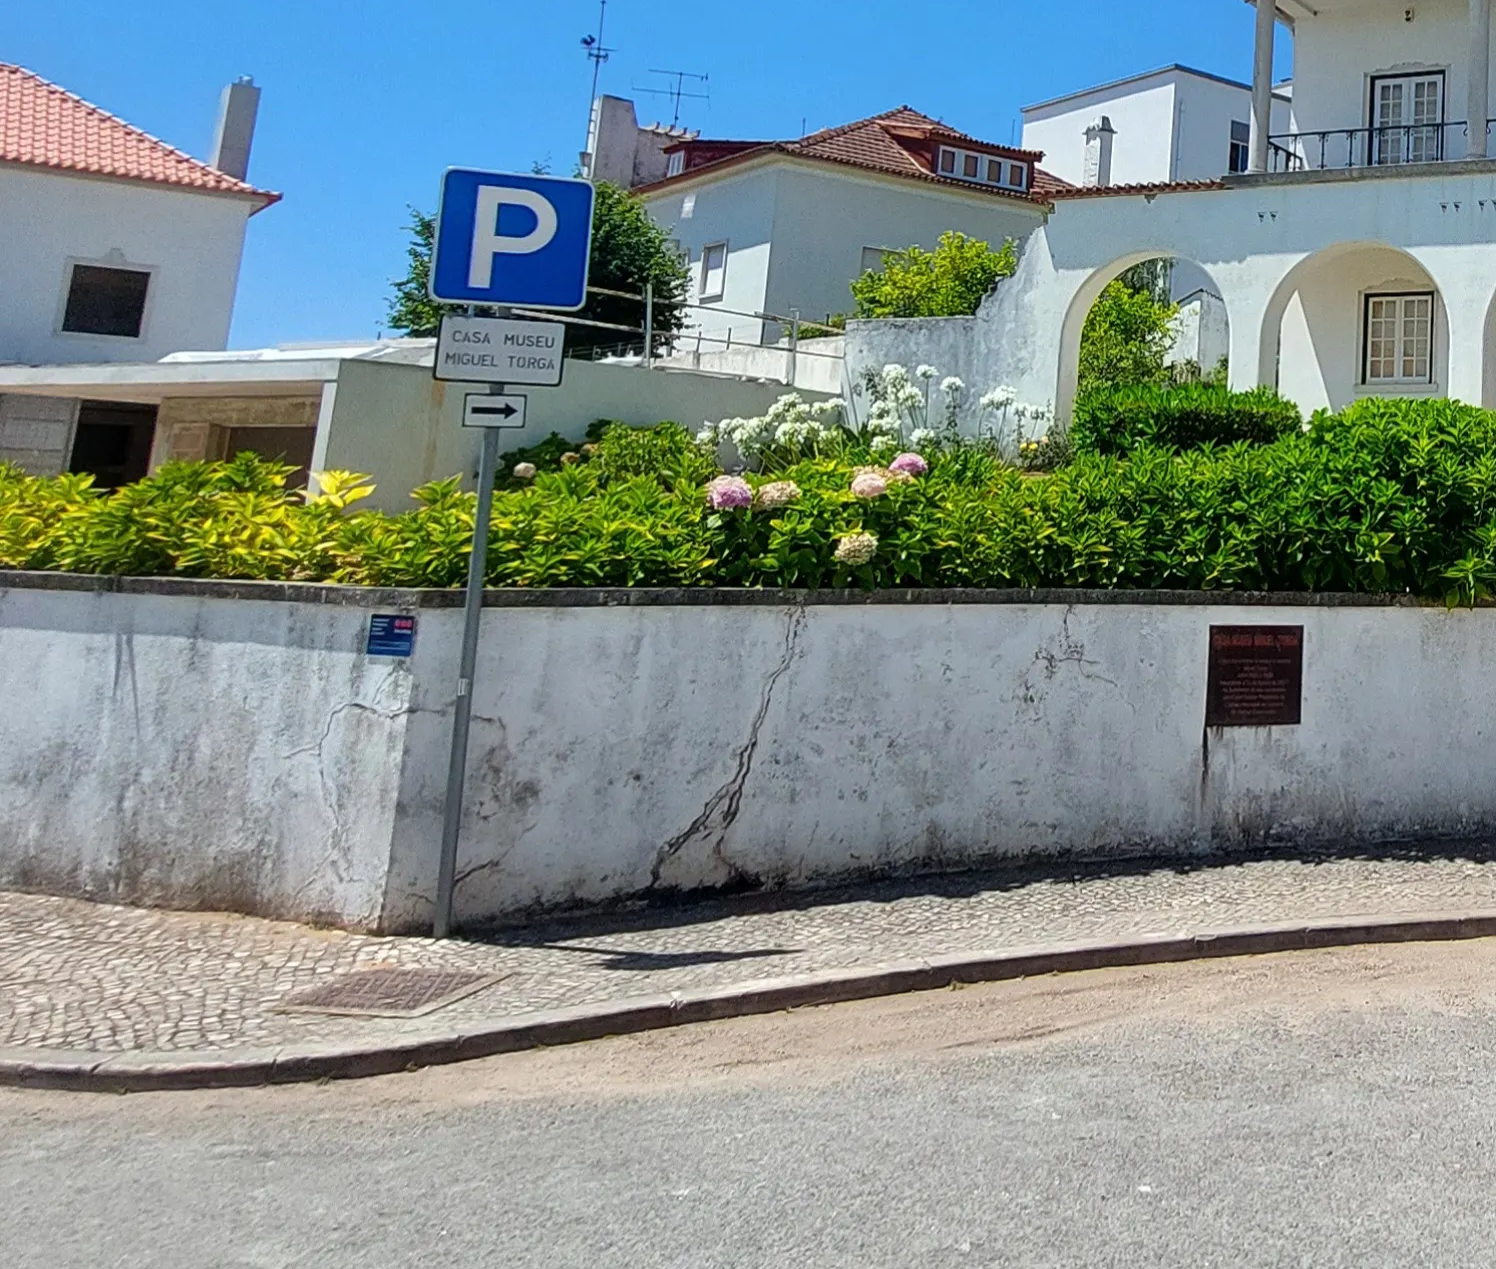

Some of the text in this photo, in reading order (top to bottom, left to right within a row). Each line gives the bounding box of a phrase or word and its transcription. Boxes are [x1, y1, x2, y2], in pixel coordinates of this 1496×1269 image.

[467, 185, 558, 289] P
[452, 330, 555, 349] CASA MUSEU
[444, 352, 555, 370] MIGUEL TORGA
